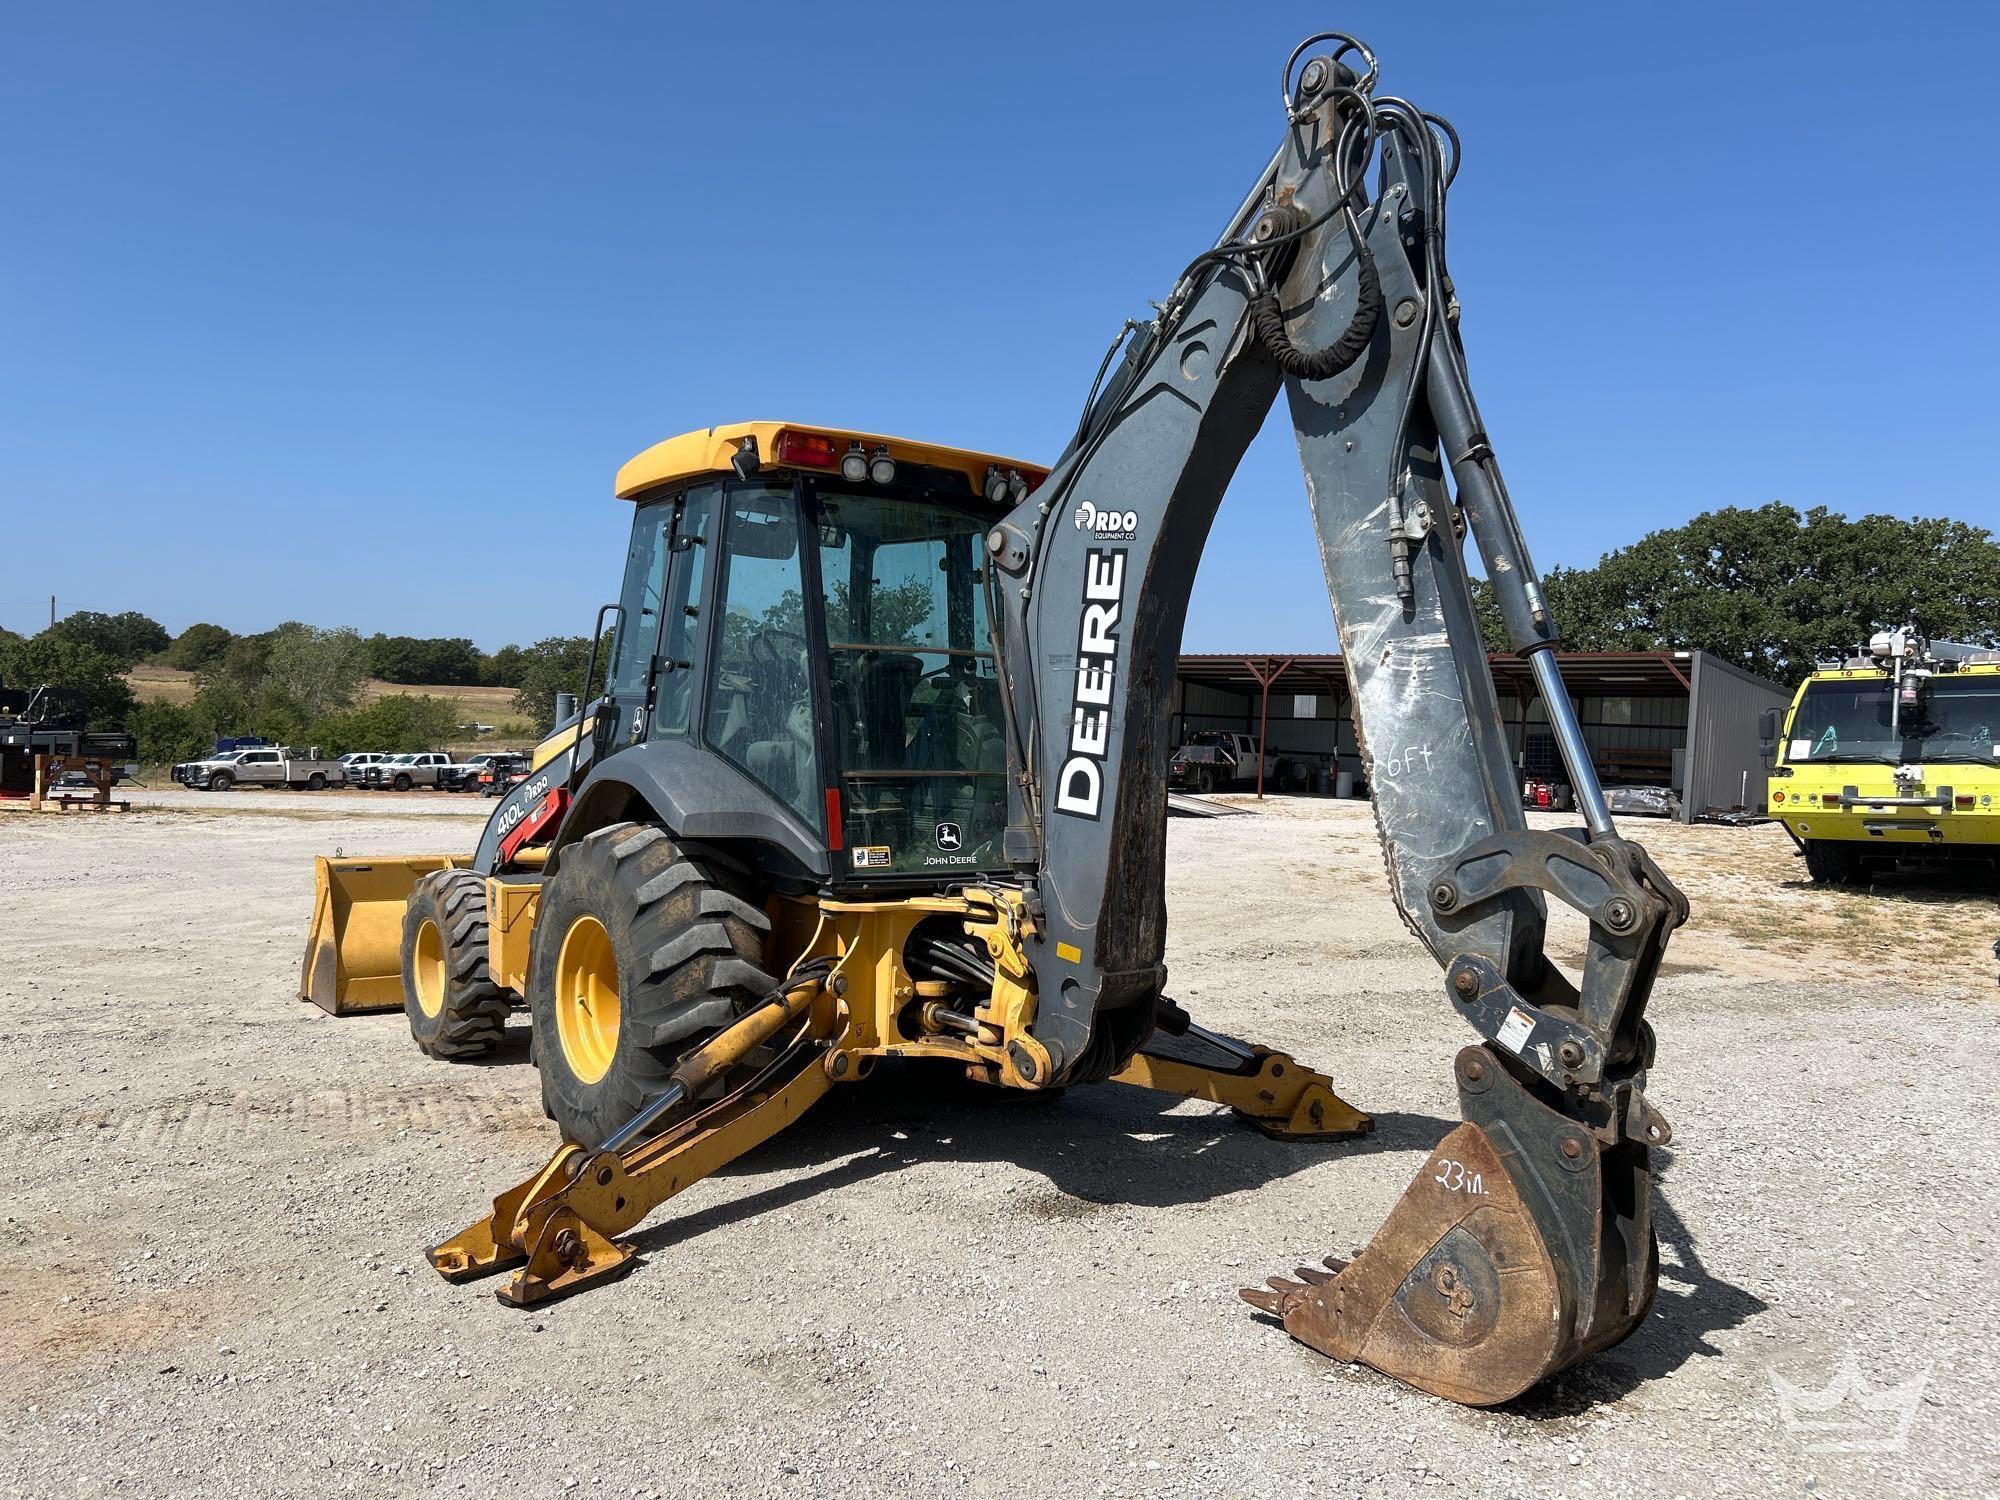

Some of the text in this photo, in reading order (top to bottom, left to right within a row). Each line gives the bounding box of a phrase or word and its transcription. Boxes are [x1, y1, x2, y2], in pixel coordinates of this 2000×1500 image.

[1096, 511, 1138, 532] RDO
[1094, 532, 1125, 540] EQUIPMENT
[1056, 552, 1125, 818] DEERE
[497, 801, 525, 836] 410L
[923, 855, 977, 866] JOHN DEERE
